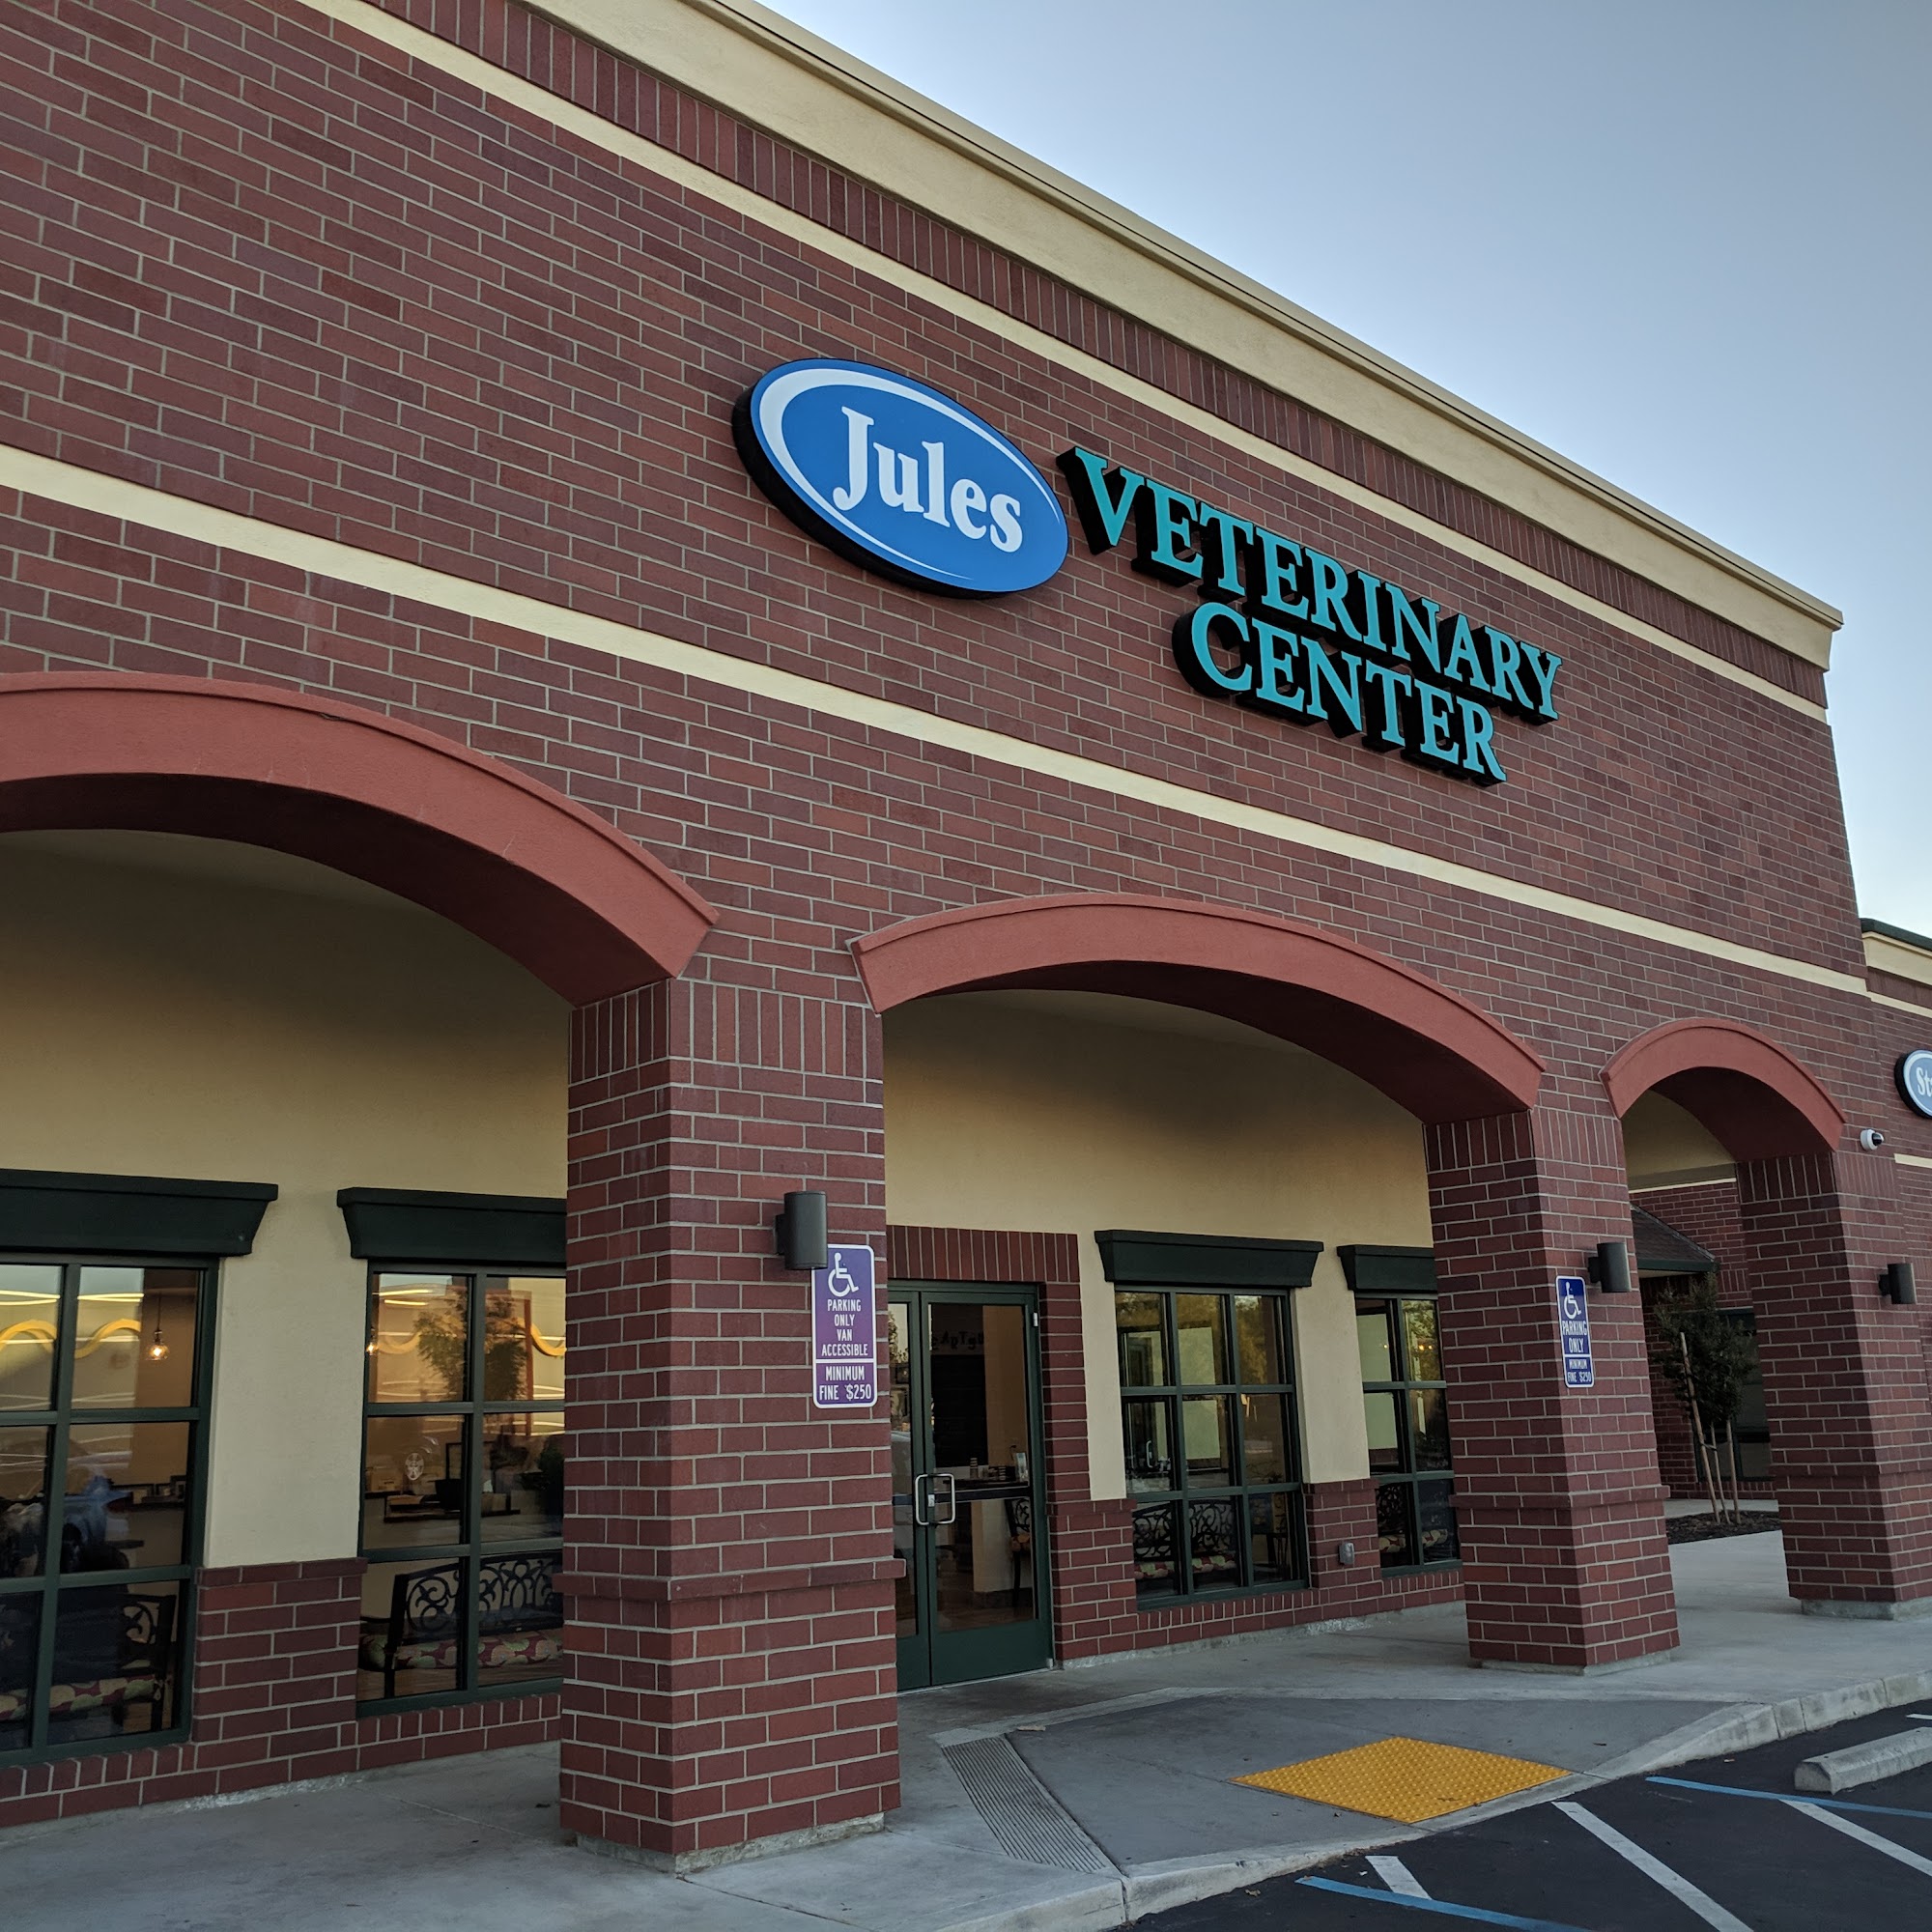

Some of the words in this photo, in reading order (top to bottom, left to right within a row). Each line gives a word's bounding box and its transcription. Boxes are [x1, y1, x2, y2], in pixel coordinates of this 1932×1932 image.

[832, 406, 1024, 554] Jules
[1072, 446, 1564, 722] VETERINARY
[1189, 602, 1508, 783] CENTER
[1917, 1066, 1932, 1096] St
[827, 1299, 862, 1312] PARKING
[834, 1314, 856, 1326] ONLY
[837, 1329, 853, 1342] VAN
[1562, 1321, 1587, 1335] PARKING
[821, 1344, 868, 1356] ACCESSIBLE
[1569, 1338, 1583, 1352] ONLY
[825, 1365, 866, 1381] MINIMUM
[819, 1384, 839, 1401] FINE
[846, 1383, 871, 1402] $250
